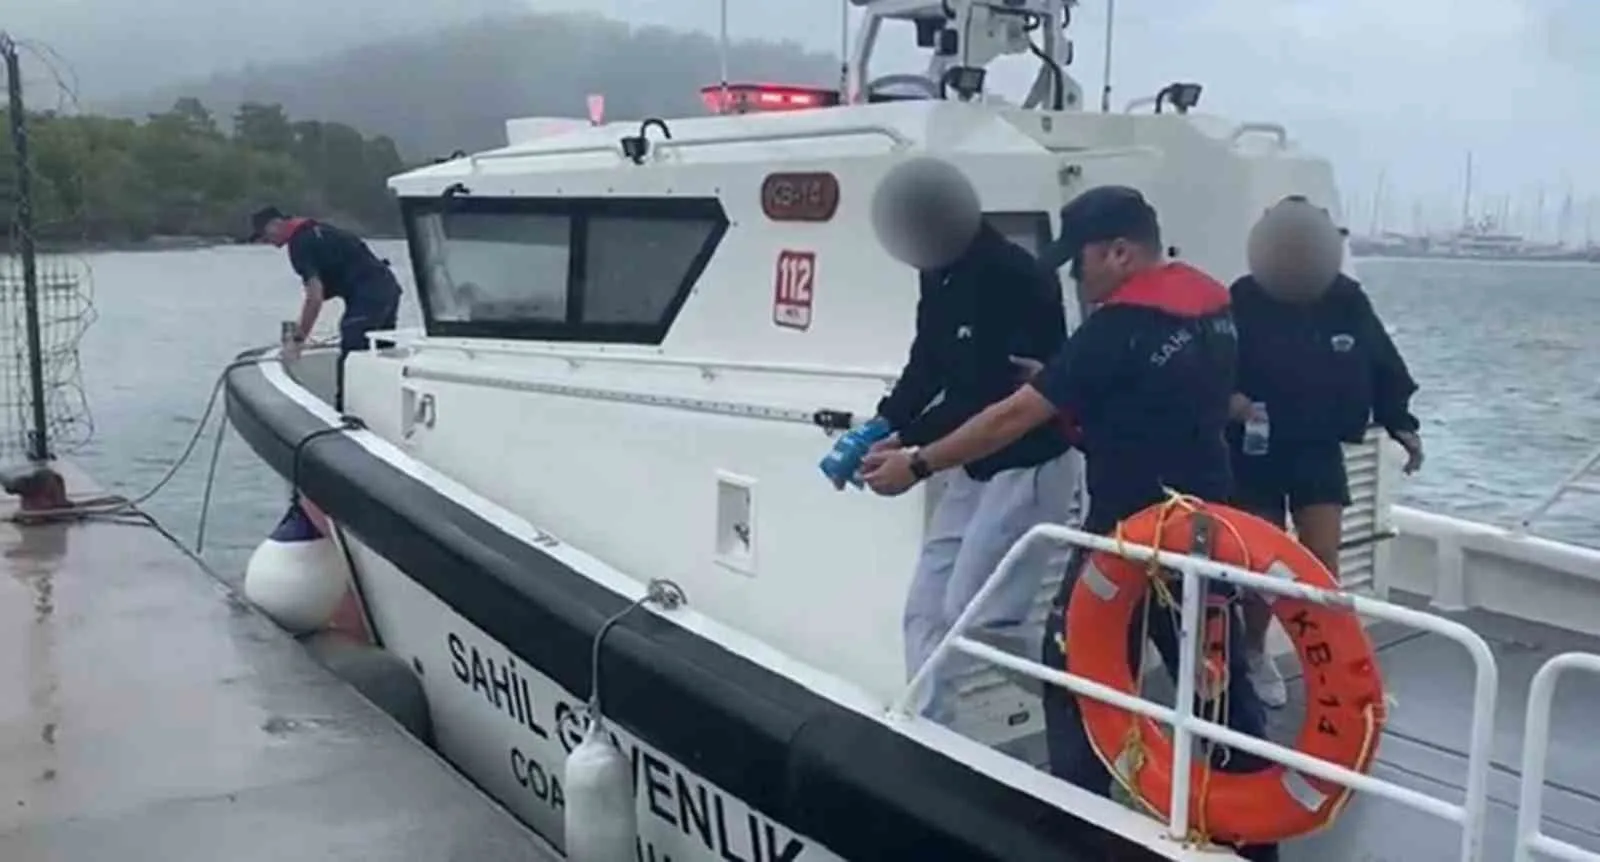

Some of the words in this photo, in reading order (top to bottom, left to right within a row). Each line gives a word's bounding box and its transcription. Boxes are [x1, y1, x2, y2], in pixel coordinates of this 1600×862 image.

[780, 256, 812, 301] 112
[448, 632, 549, 740] SAHİL
[1288, 610, 1342, 737] KB-14
